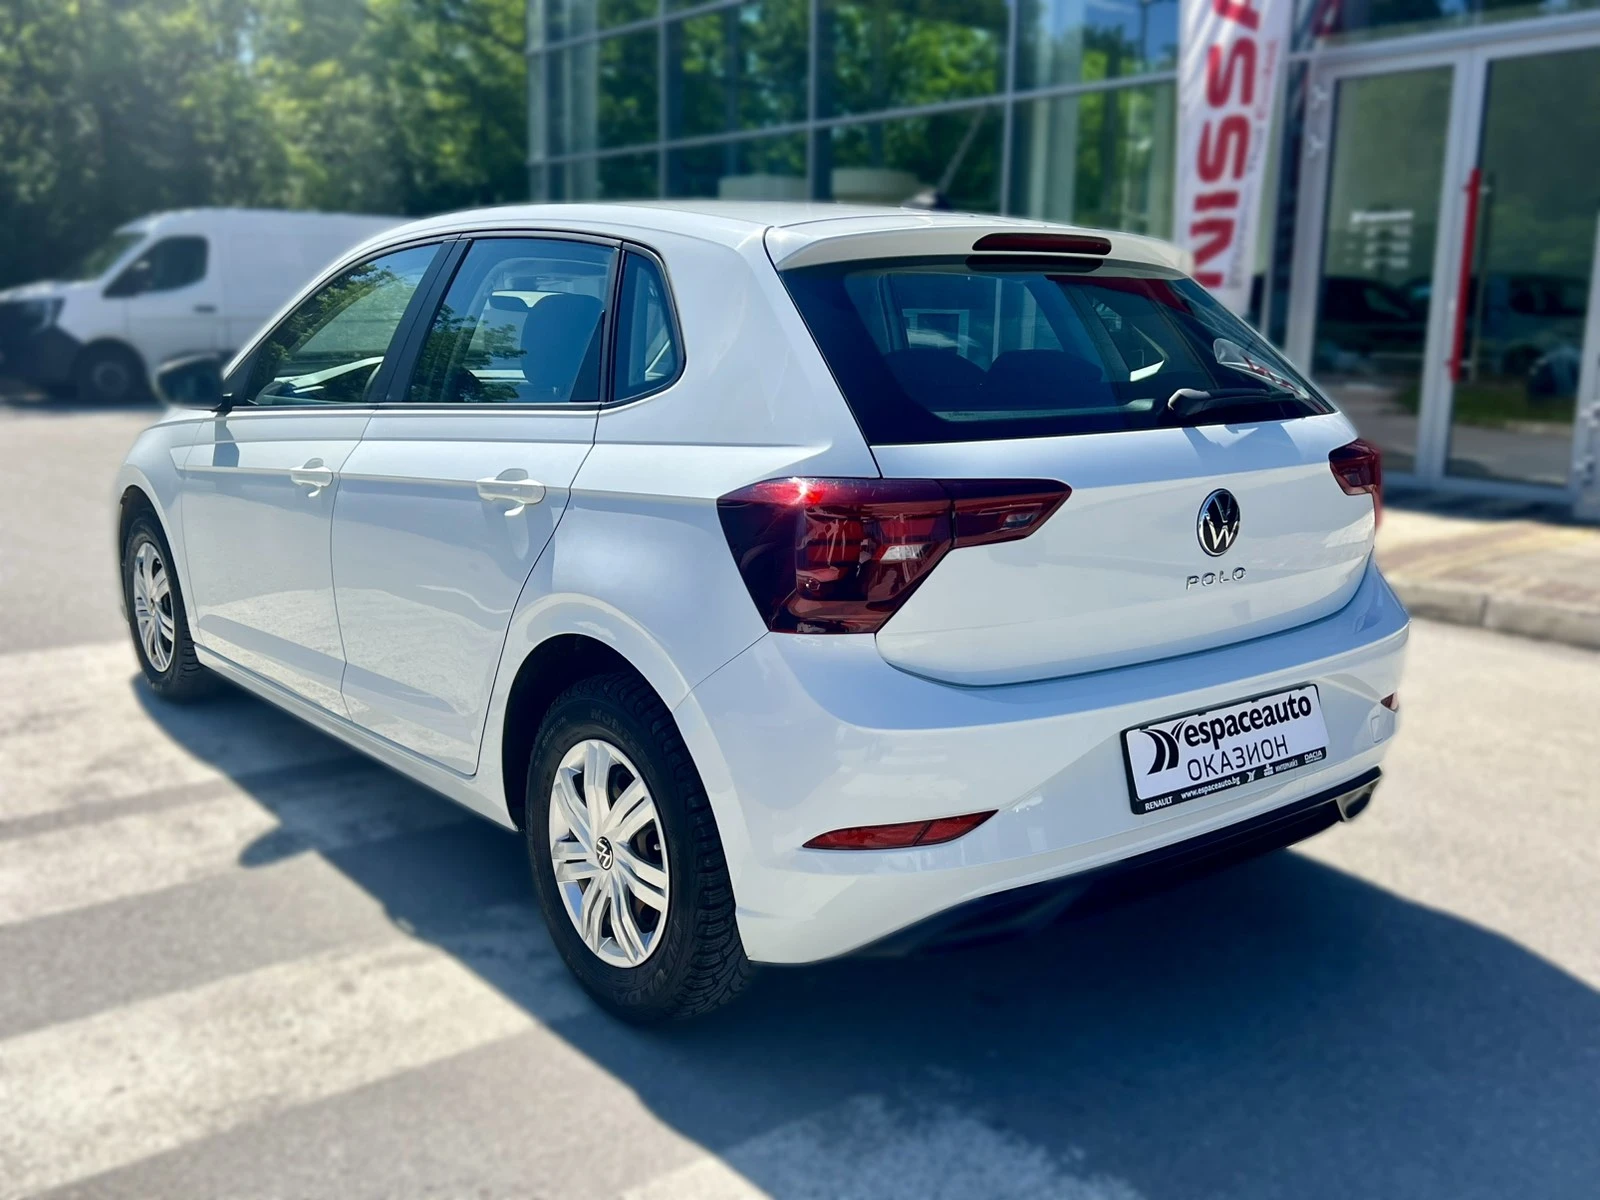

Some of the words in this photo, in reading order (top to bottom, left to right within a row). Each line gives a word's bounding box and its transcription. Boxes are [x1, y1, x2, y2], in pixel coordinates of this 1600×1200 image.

[1185, 566, 1246, 591] POLO
[1184, 694, 1312, 750] espaceauto
[1187, 734, 1289, 781] ОКАЗИОН
[1303, 749, 1323, 762] DACIA
[1144, 795, 1173, 811] RENAULT
[1181, 776, 1241, 800] www.espaceauto.bg
